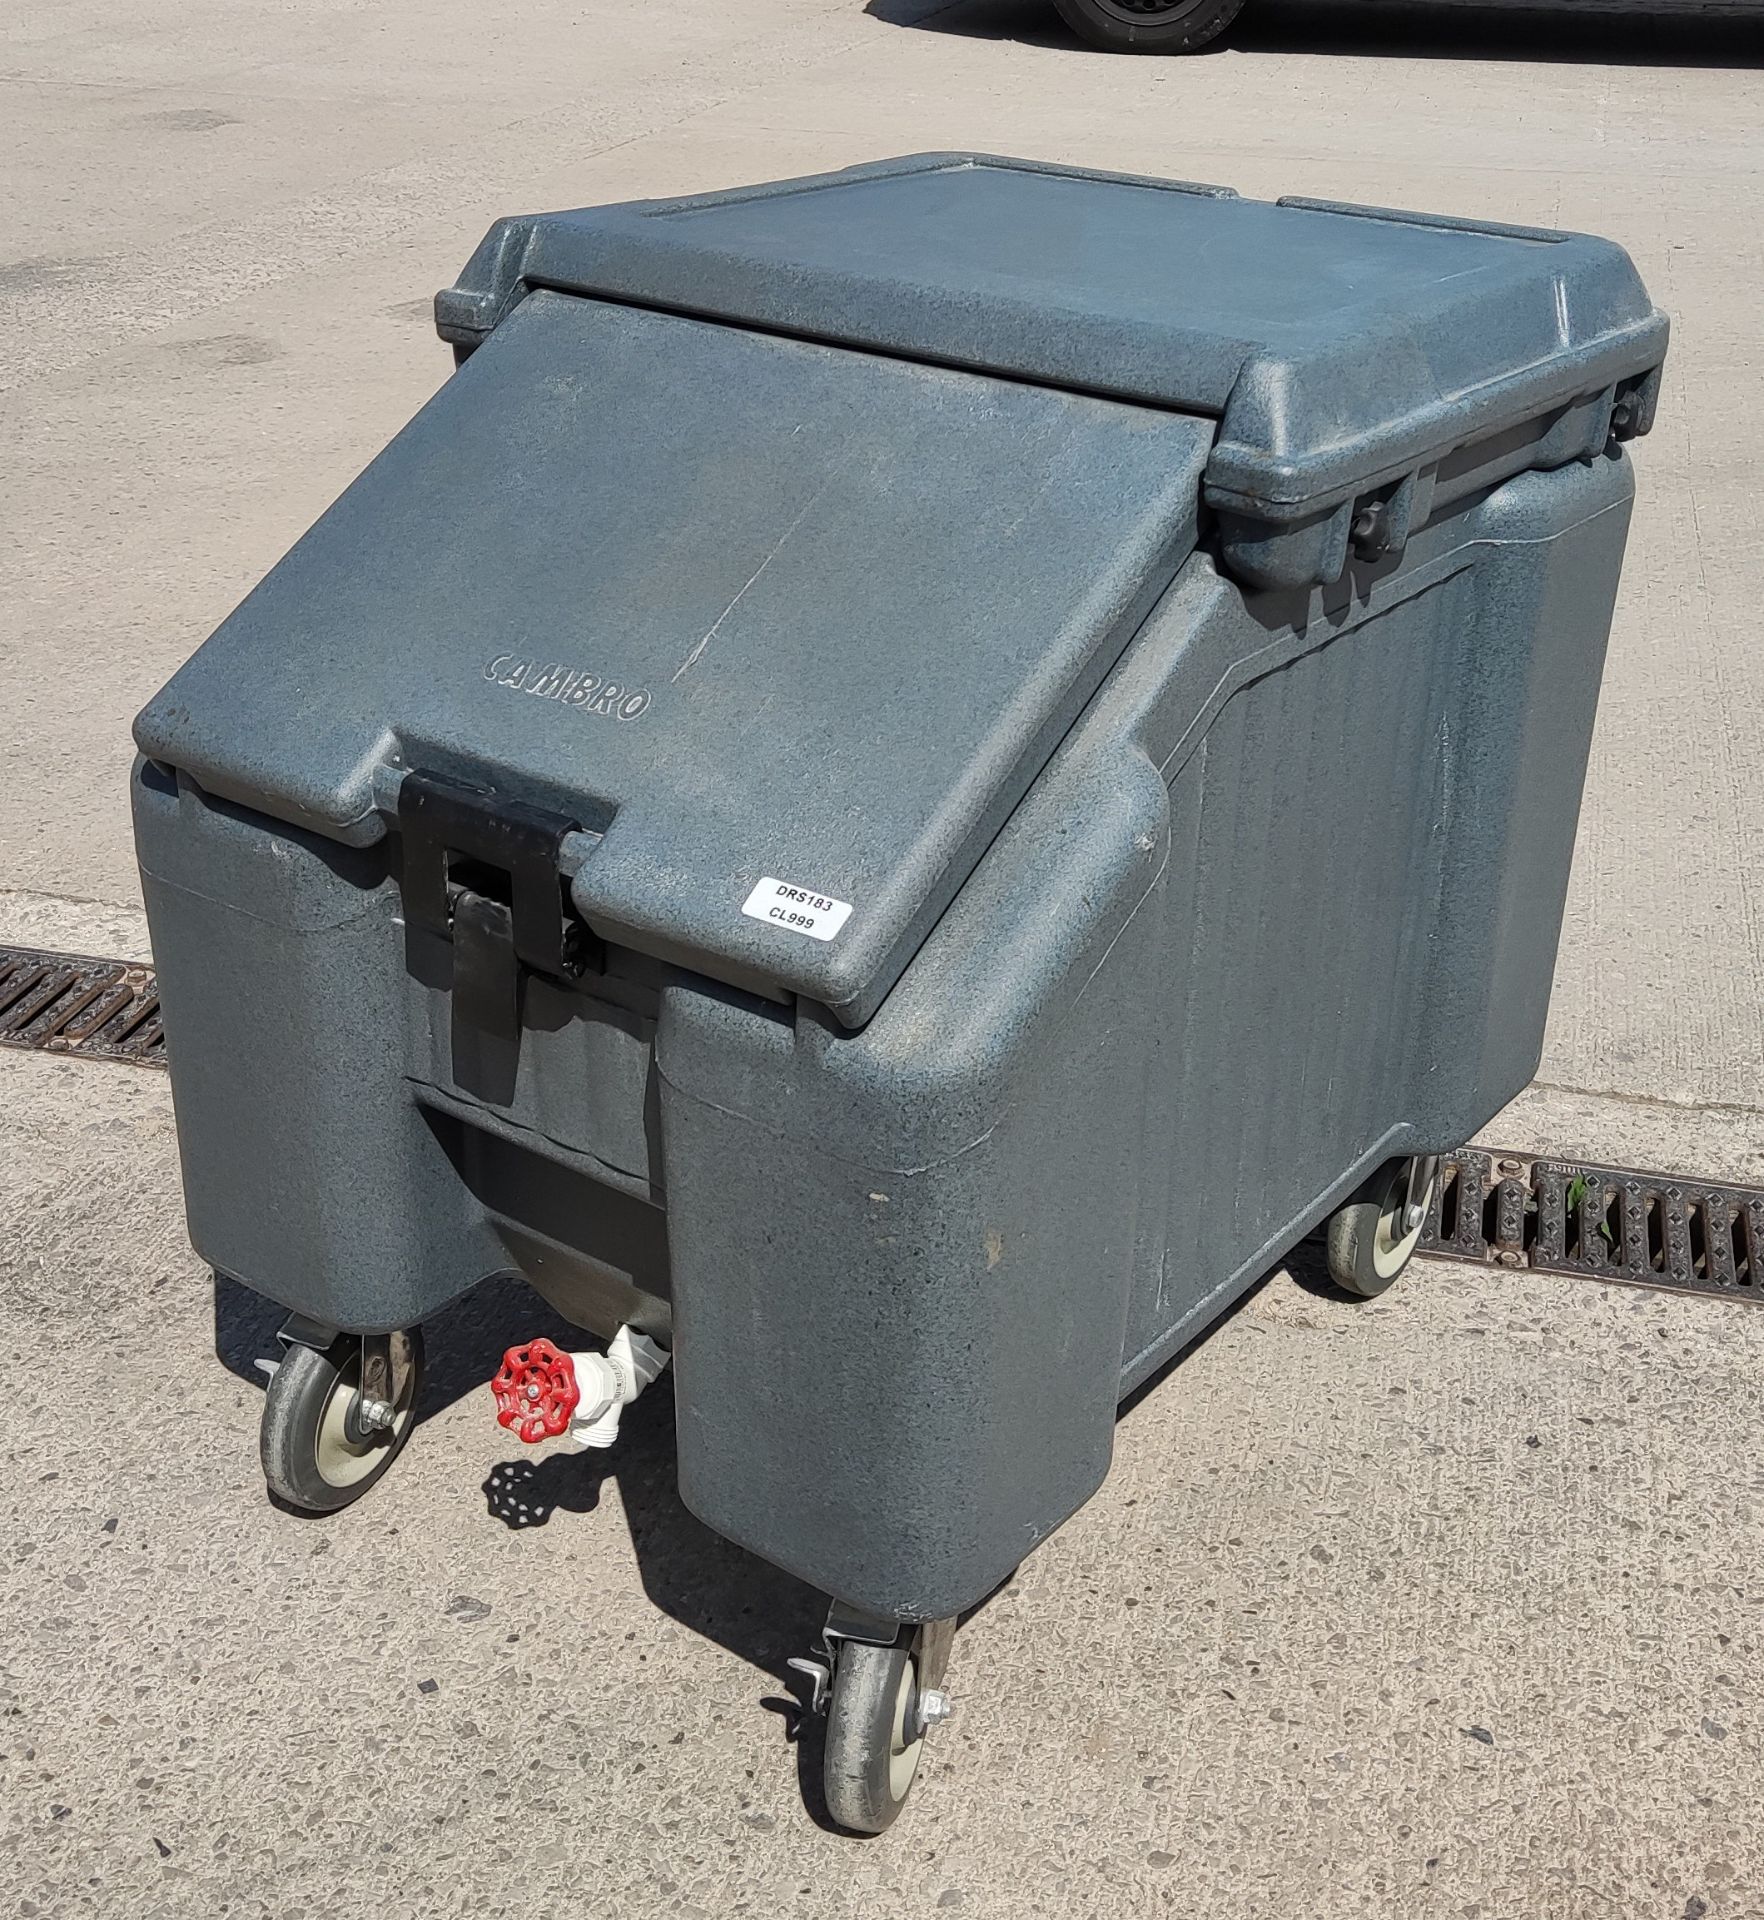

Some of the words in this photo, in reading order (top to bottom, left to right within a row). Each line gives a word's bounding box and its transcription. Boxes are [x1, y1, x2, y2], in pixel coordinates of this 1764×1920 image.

[484, 651, 651, 720] CAMBRO
[775, 885, 833, 912] DRS183
[769, 906, 815, 929] CL999
